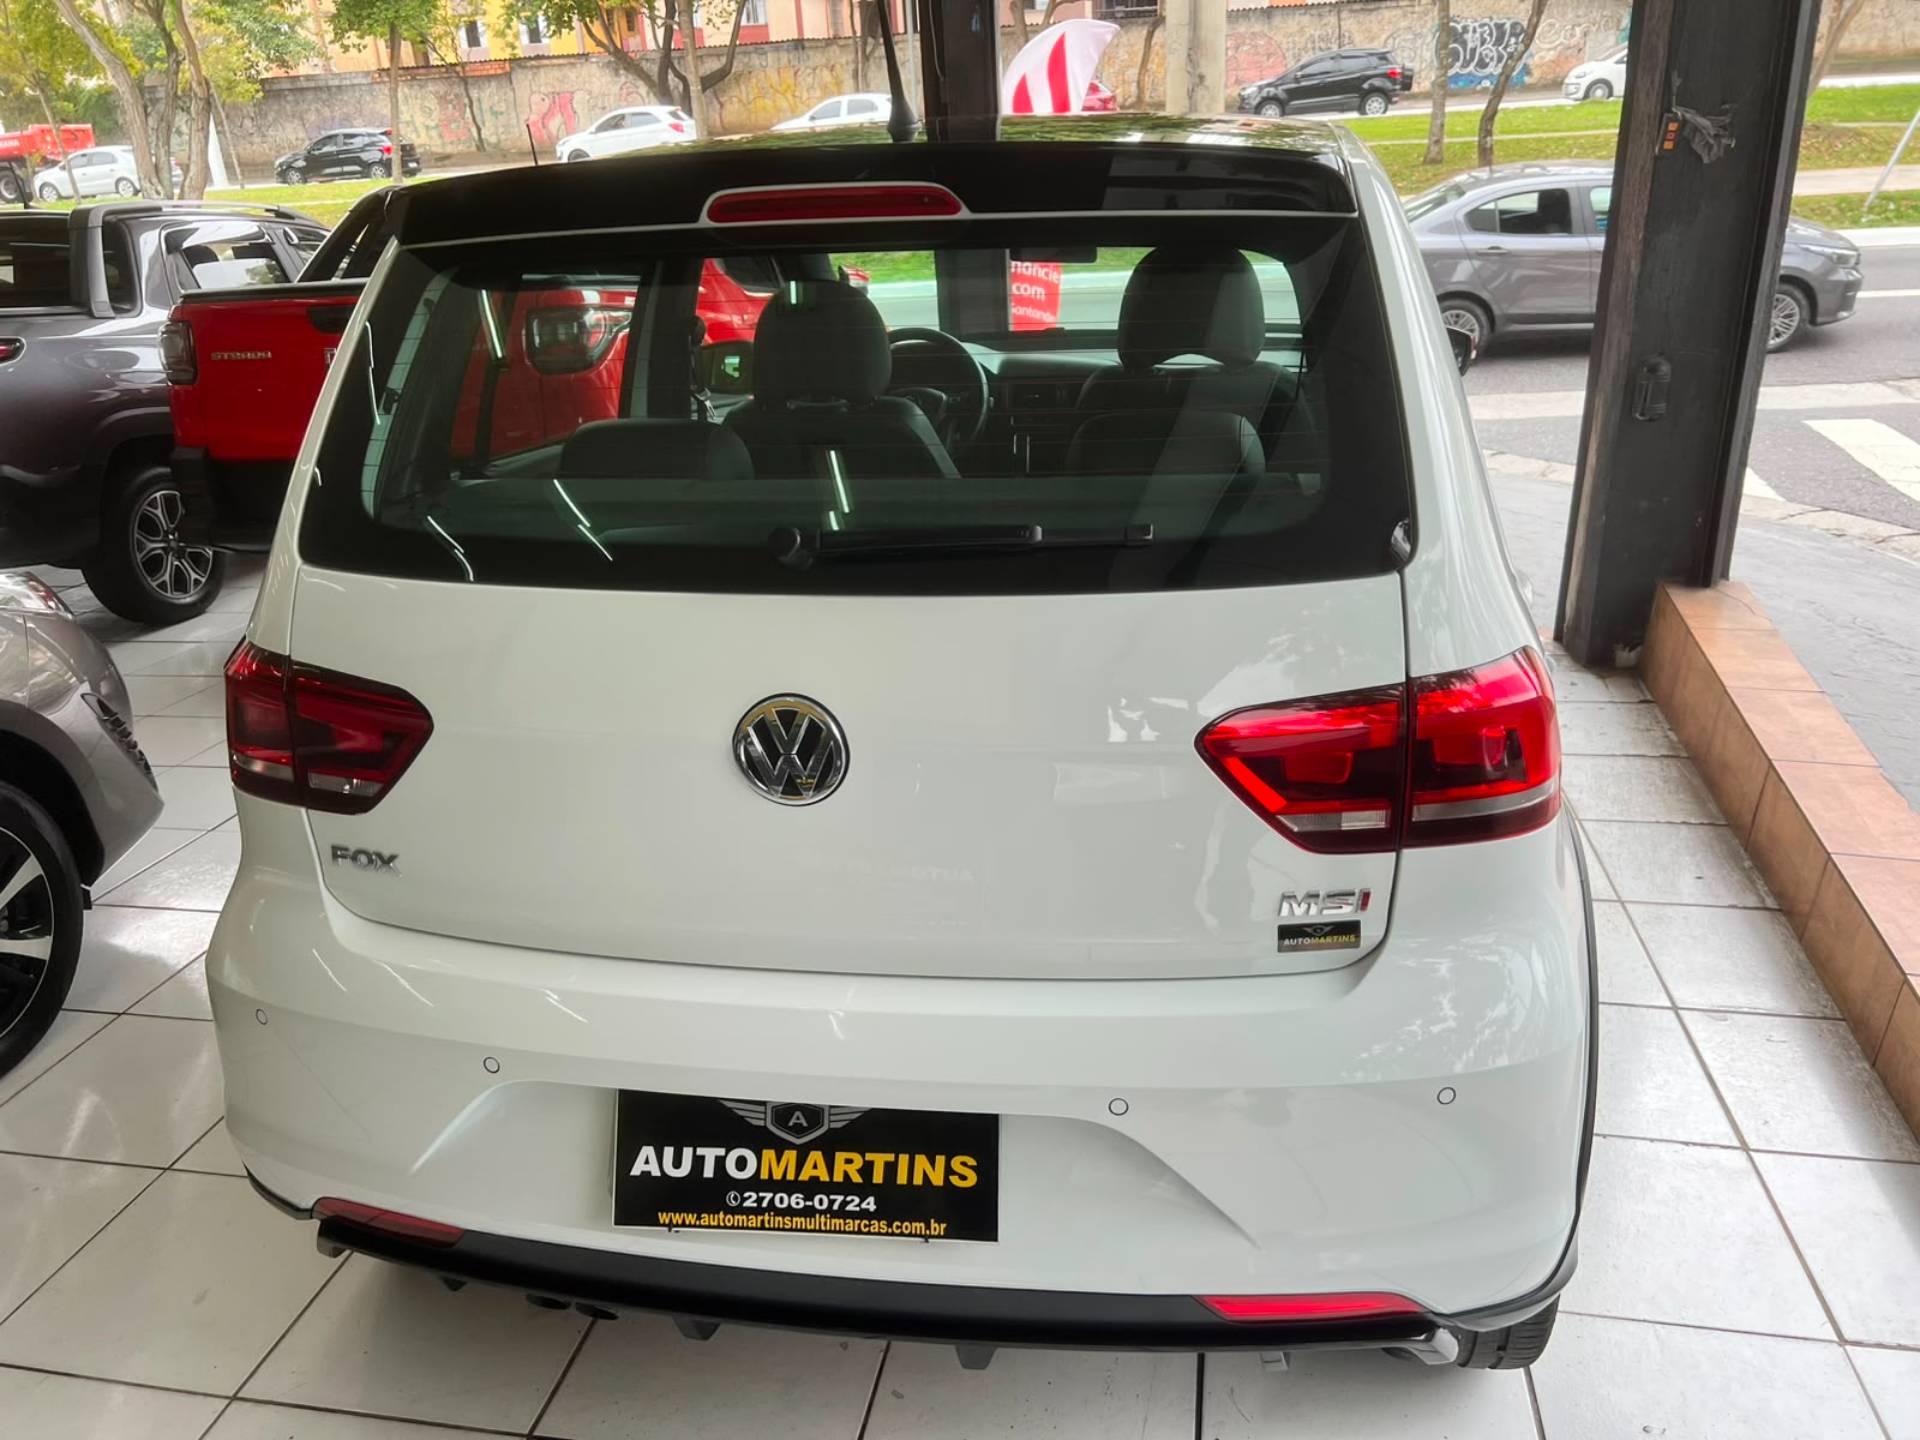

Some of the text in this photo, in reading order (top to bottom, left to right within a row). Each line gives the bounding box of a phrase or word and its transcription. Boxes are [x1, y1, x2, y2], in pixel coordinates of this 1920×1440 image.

[331, 844, 400, 873] FOX
[1283, 934, 1356, 946] AUTOMARTINS
[787, 1110, 808, 1127] A
[630, 1145, 978, 1188] AUTOMARTINS
[742, 1191, 876, 1212] 2706-0724
[658, 1209, 947, 1236] www.automartinsmultimarcas.com.br
